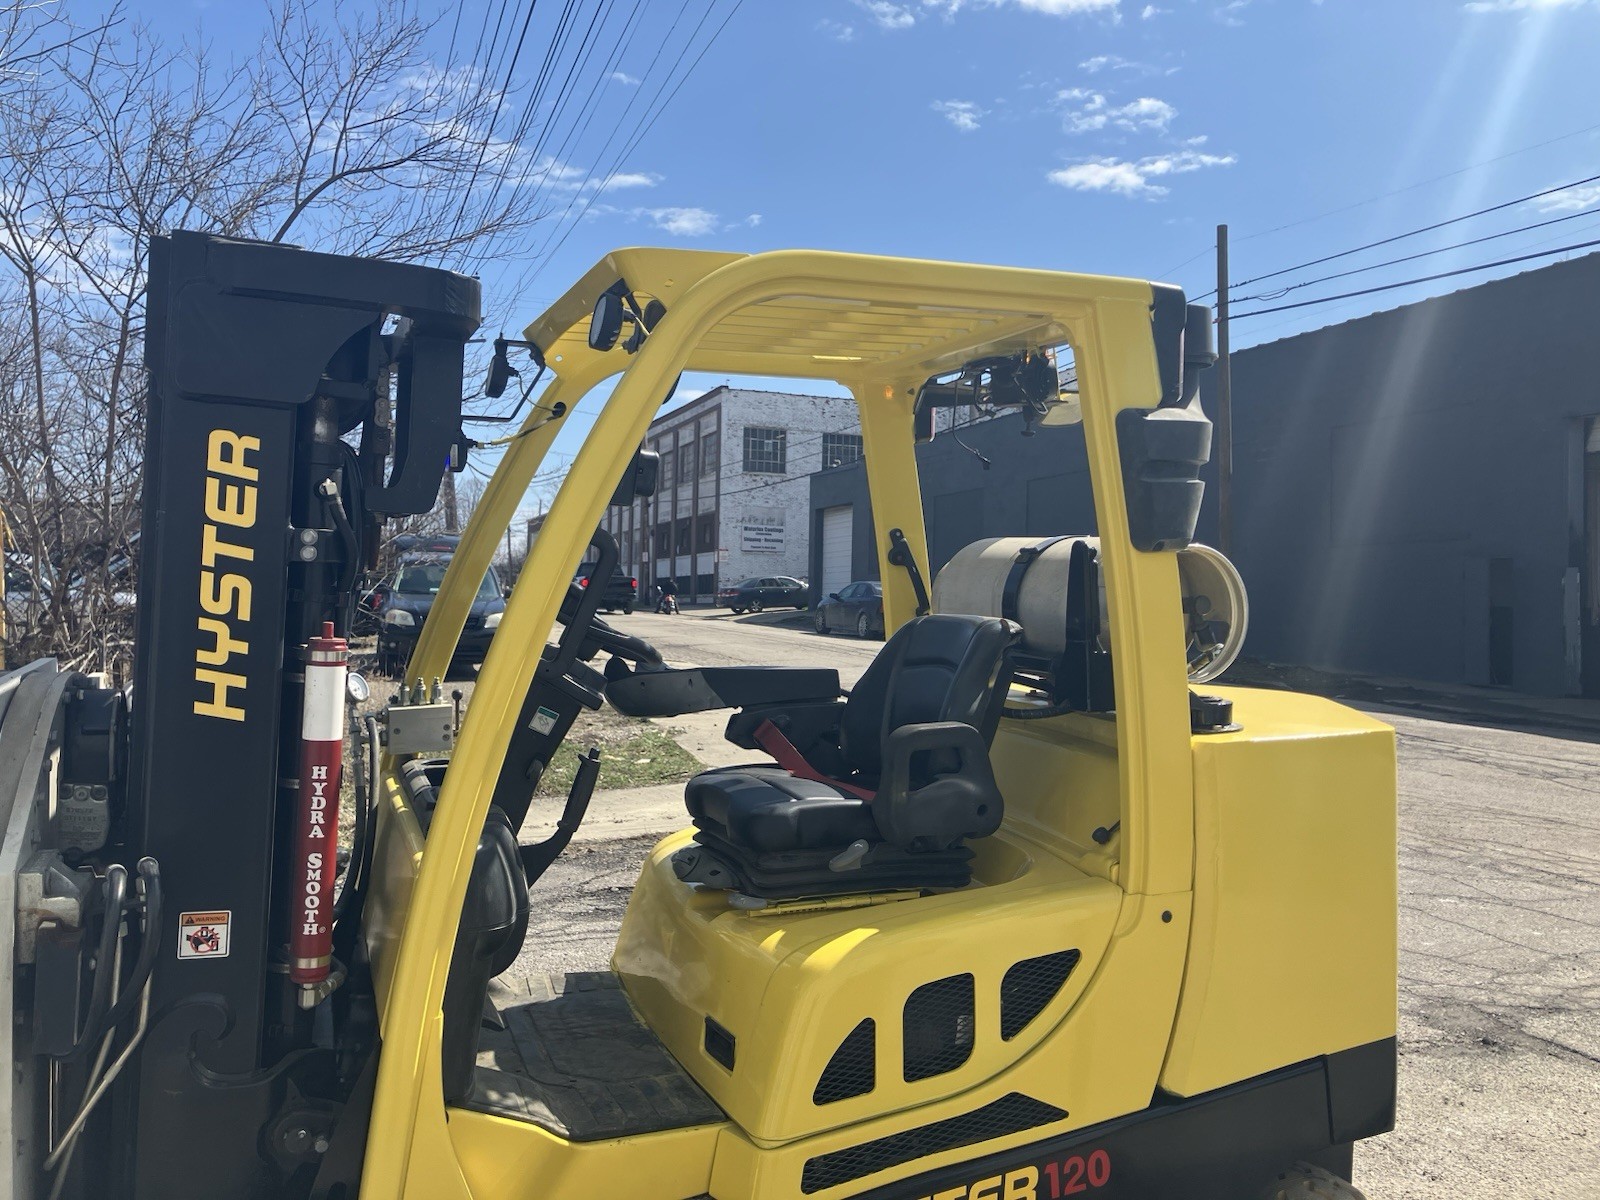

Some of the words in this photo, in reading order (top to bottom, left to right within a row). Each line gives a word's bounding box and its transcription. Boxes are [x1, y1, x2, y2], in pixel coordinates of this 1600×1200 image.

[194, 429, 260, 721] HYSTER
[308, 765, 328, 839] HYDRA
[1044, 1149, 1111, 1199] 120
